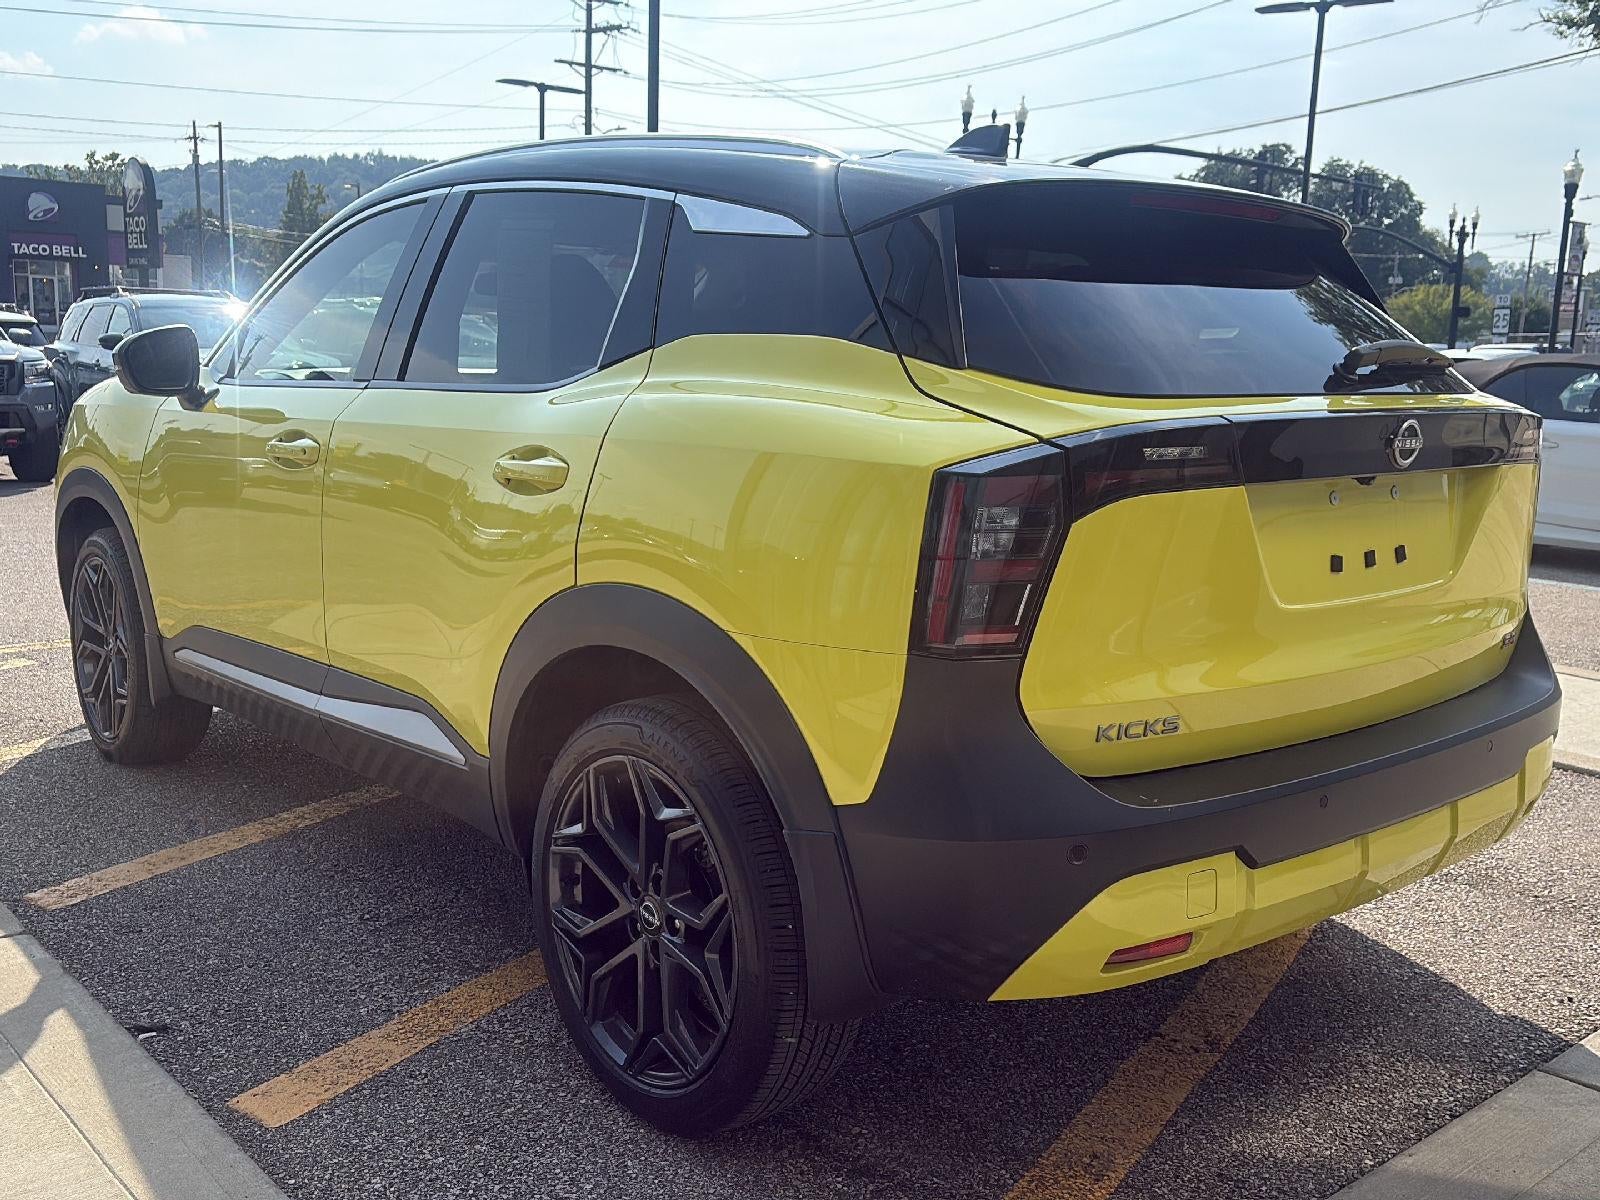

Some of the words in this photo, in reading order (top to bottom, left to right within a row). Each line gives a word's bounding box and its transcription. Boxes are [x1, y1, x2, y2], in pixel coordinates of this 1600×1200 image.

[125, 216, 146, 232] TACO
[127, 232, 148, 249] BELL
[11, 242, 50, 255] TACO
[52, 244, 87, 258] BELL
[1493, 313, 1509, 329] 25
[1095, 714, 1180, 742] KICKS
